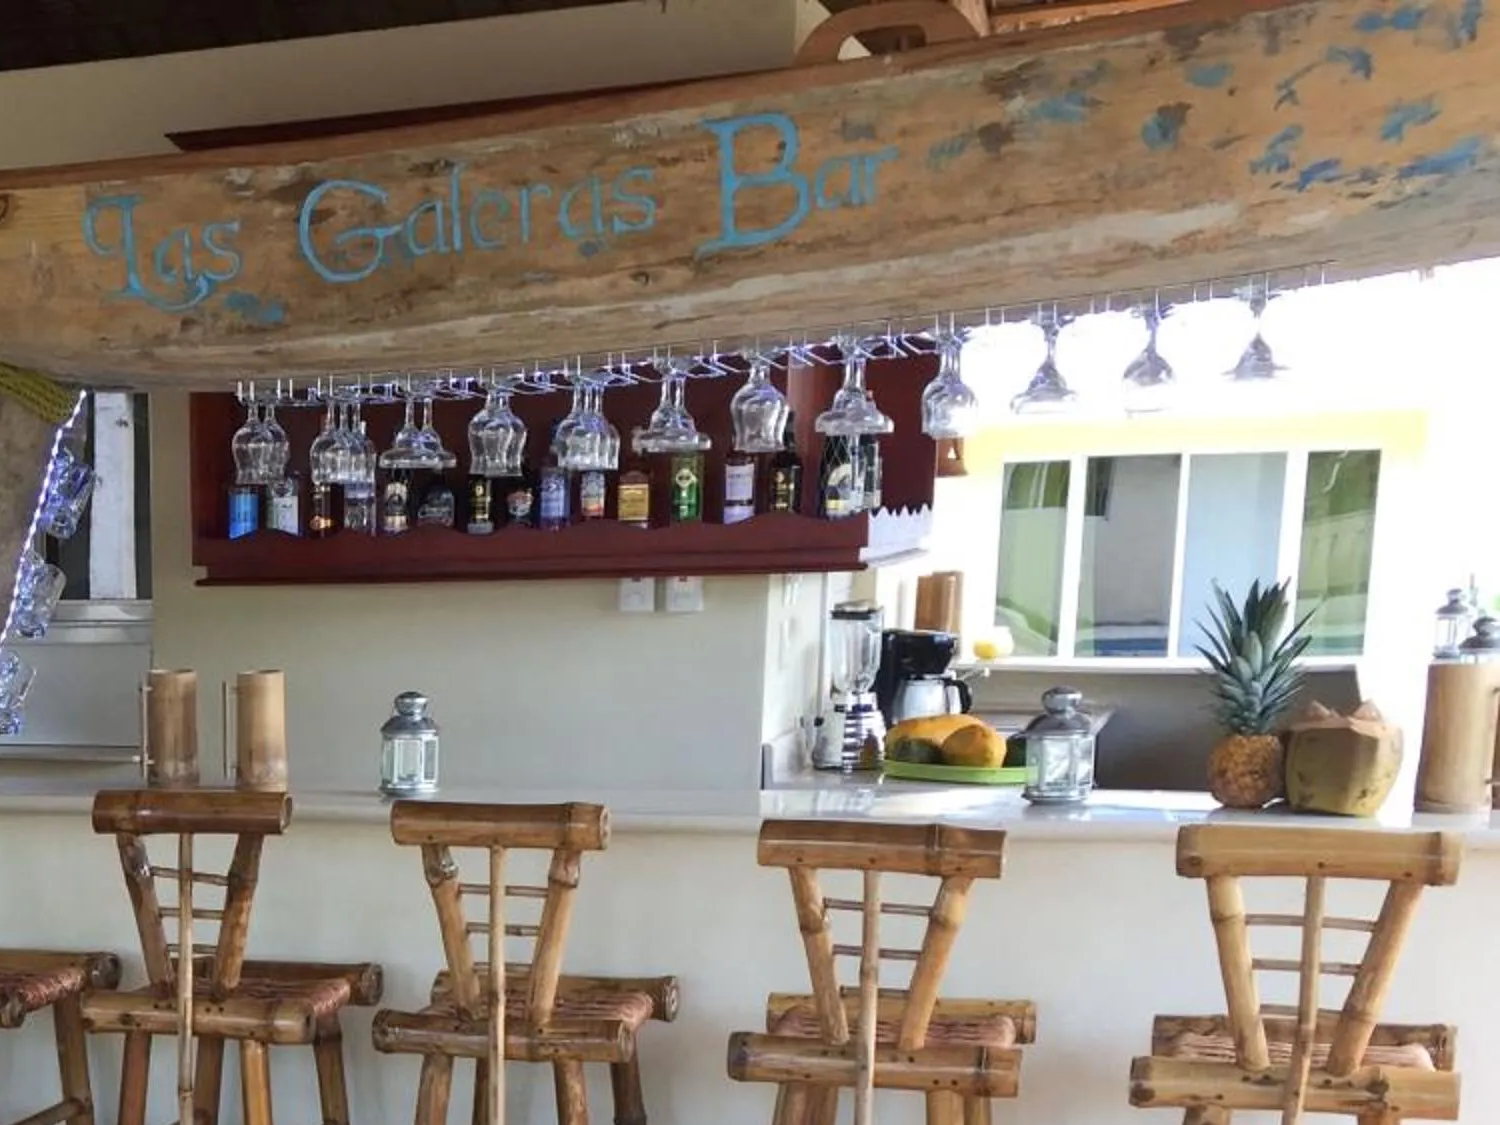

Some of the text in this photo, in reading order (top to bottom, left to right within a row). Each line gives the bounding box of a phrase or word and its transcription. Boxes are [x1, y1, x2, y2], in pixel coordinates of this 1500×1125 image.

[83, 112, 898, 312] Las Galeras Bar
